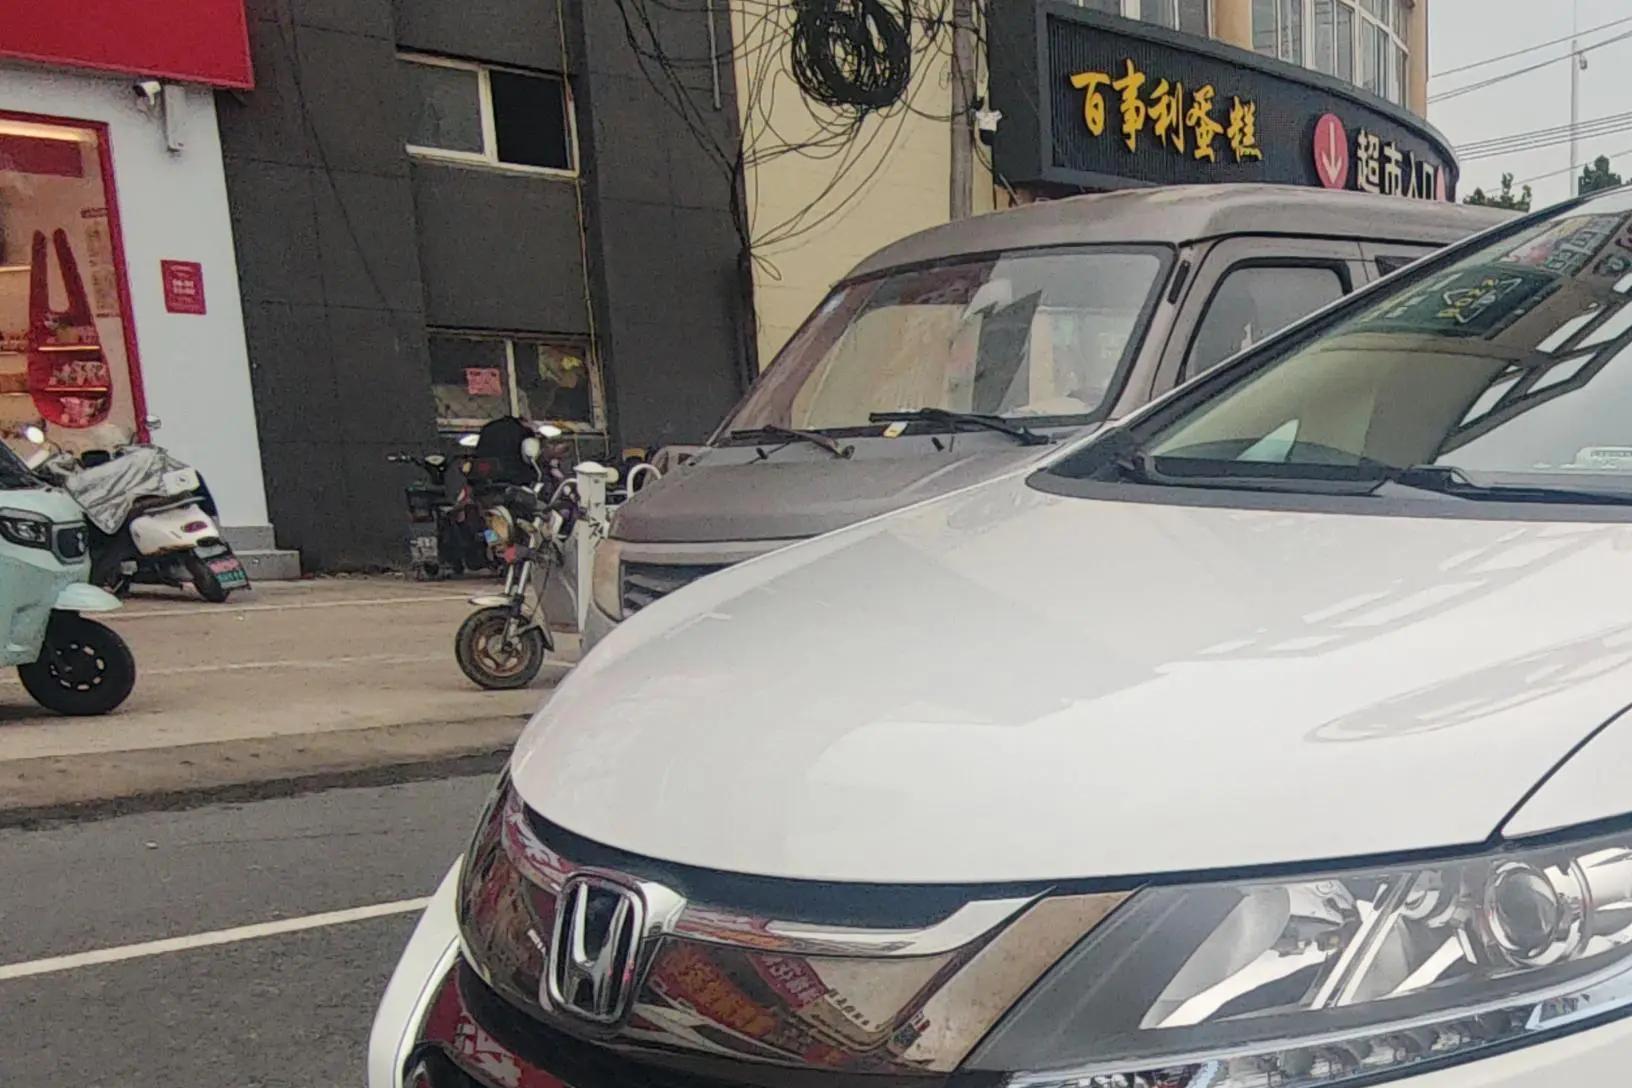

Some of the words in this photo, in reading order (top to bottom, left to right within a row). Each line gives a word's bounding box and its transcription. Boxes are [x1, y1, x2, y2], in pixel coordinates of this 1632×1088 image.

[1070, 58, 1263, 163] 百事利蛋糕
[1357, 127, 1434, 200] 超市入口
